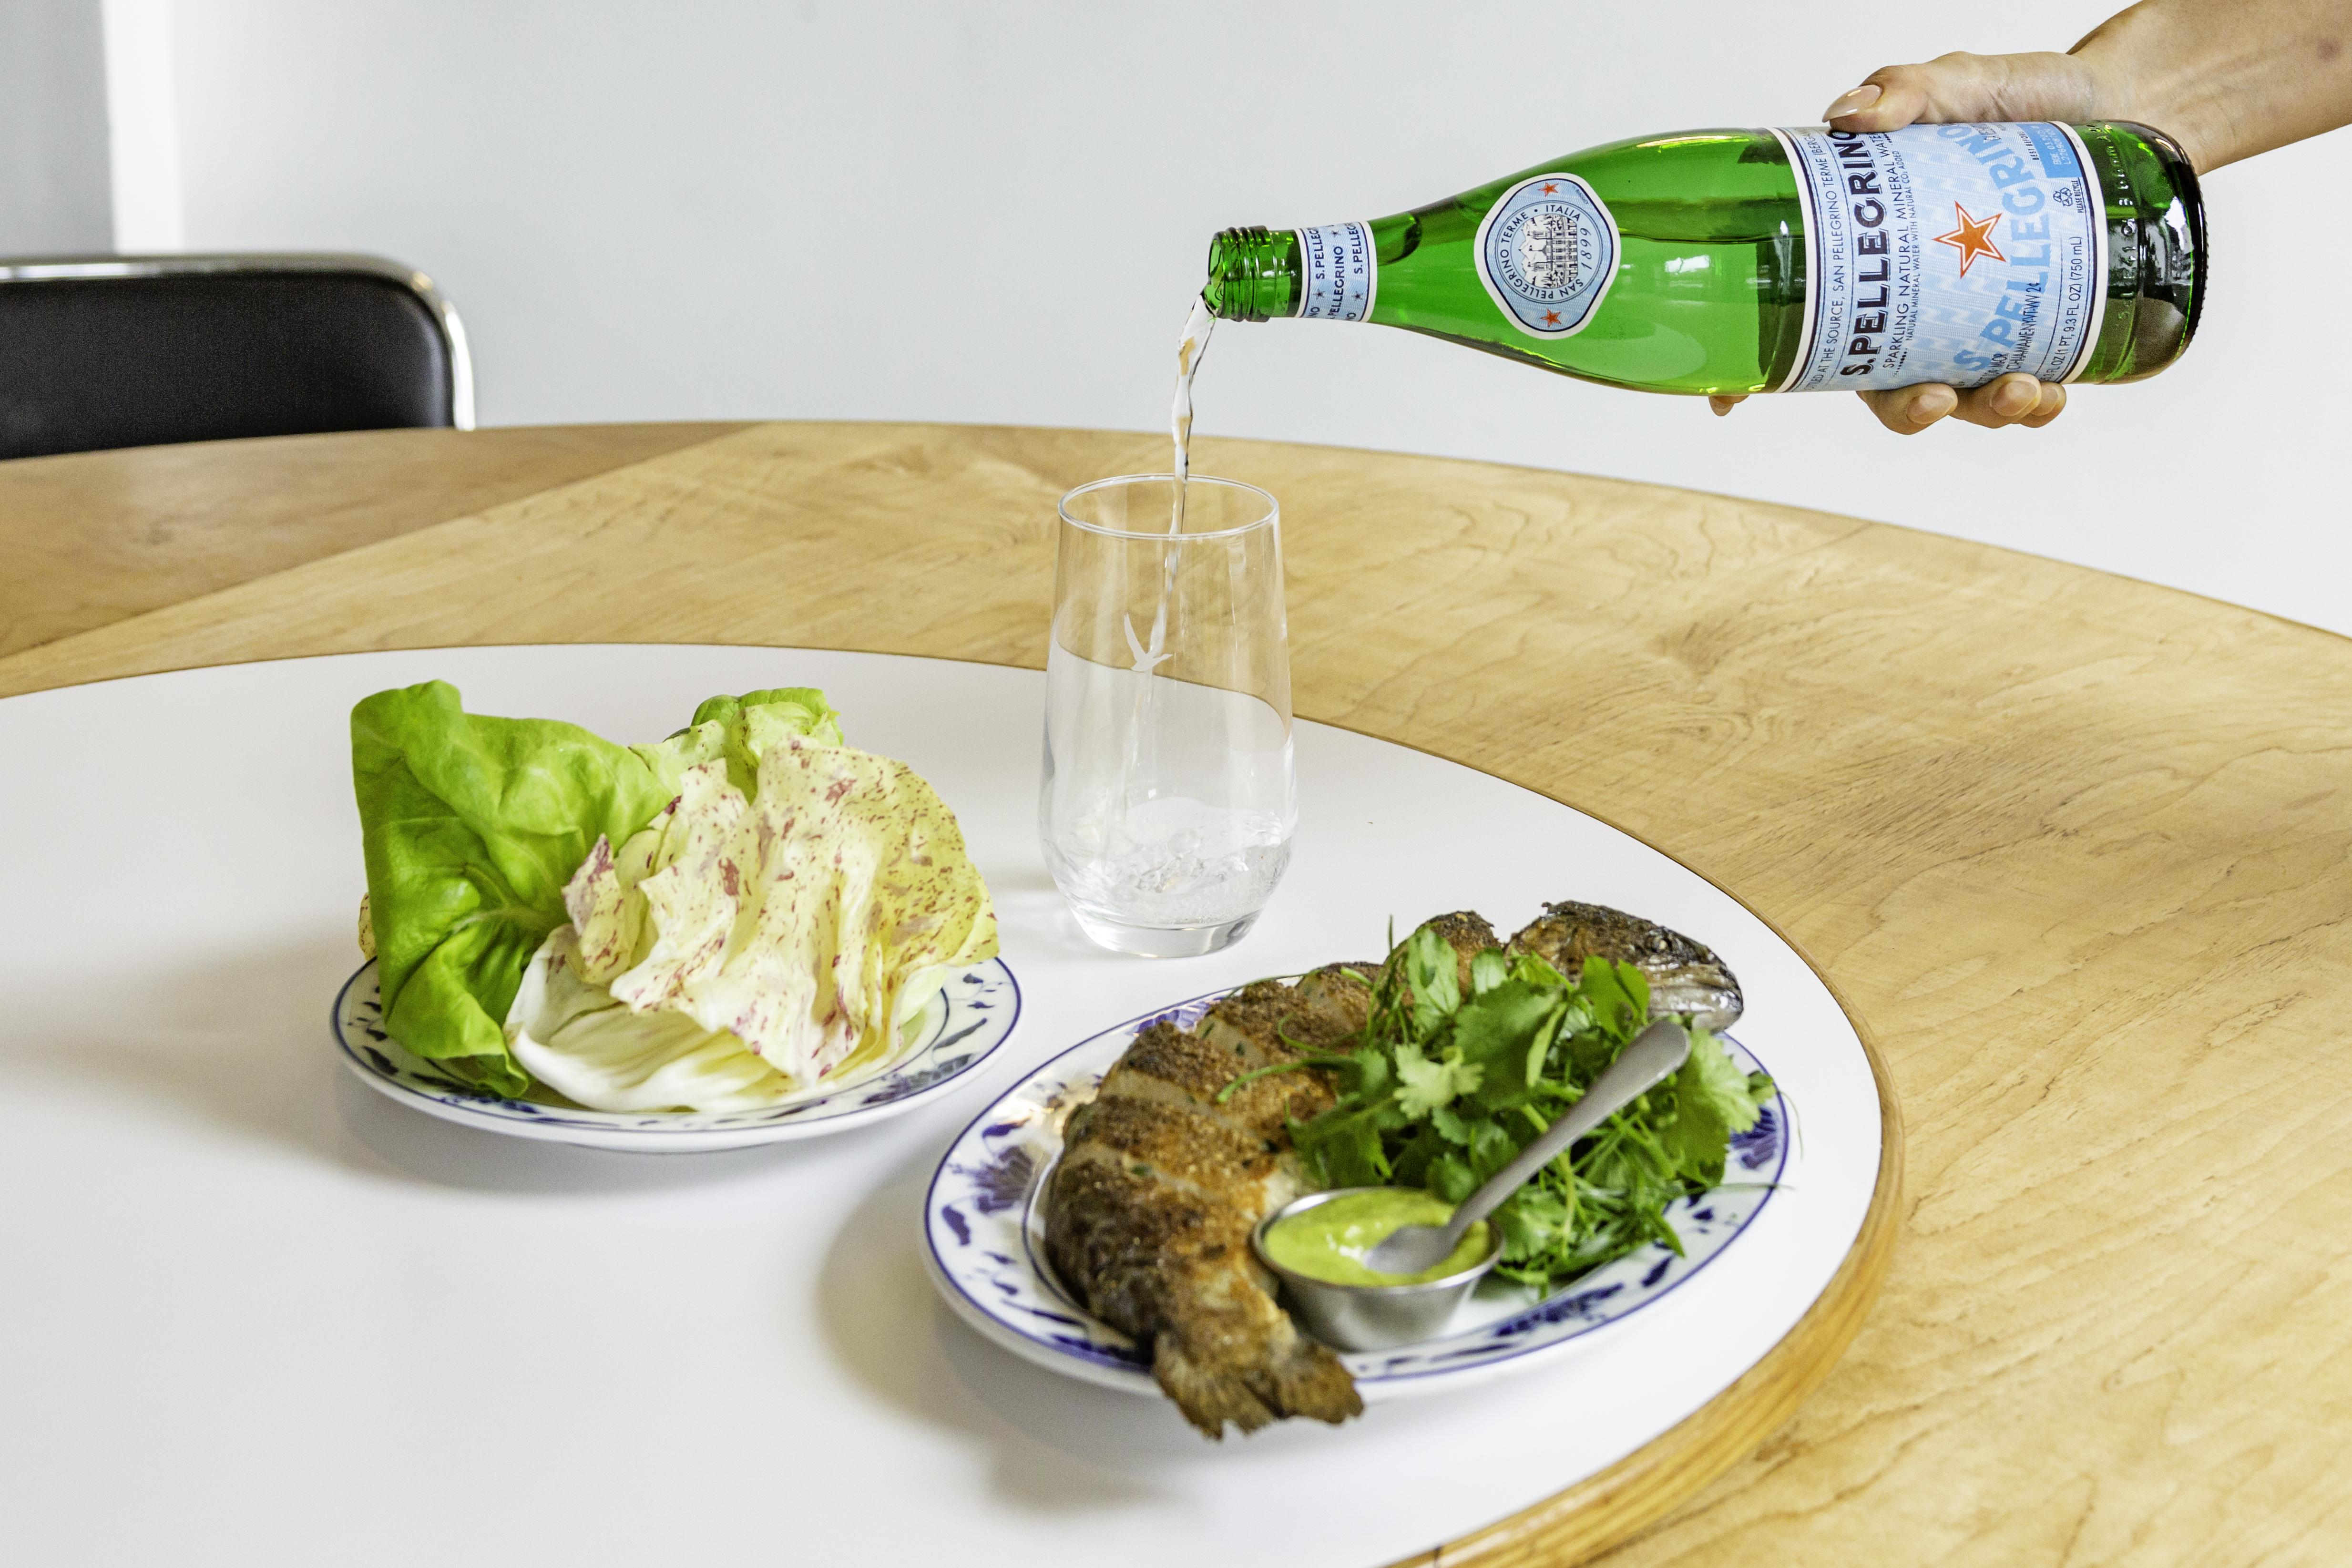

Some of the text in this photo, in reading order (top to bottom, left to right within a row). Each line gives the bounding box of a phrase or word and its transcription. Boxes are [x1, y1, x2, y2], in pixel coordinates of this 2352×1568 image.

[1892, 151, 1905, 169] ADDED
[2028, 149, 2039, 160] BEST
[1815, 158, 1834, 187] TERME
[1884, 162, 1907, 219] MINERAL
[1904, 187, 1916, 218] NATURAL
[2072, 180, 2084, 213] PLEASE RECYCLE
[1826, 191, 1844, 260] PELLEGRINO
[1910, 222, 1919, 241] WITH
[1500, 205, 1583, 299] SAN PELLEGRINO TERME ITALIA
[1580, 227, 1592, 270] 1899
[1827, 132, 1890, 376] S.PELLEGRINO
[2069, 237, 2084, 256] mL)
[1898, 226, 1911, 297] NATURAL
[2069, 259, 2084, 280] (750
[1833, 265, 1845, 291] SAN
[1911, 274, 1920, 307] MINERAL
[2026, 282, 2042, 292] 2¢
[2069, 284, 2083, 301] OZ)
[1826, 297, 1845, 344] SOURCE,
[2067, 304, 2079, 316] FL
[1883, 303, 1909, 368] SPARKLING
[1906, 310, 1917, 340] NATURAL
[2064, 319, 2077, 332] 9.3
[2059, 335, 2075, 346] PT,
[1821, 348, 1835, 362] THE
[2051, 356, 2066, 366] OZ
[1819, 364, 1829, 373] AT
